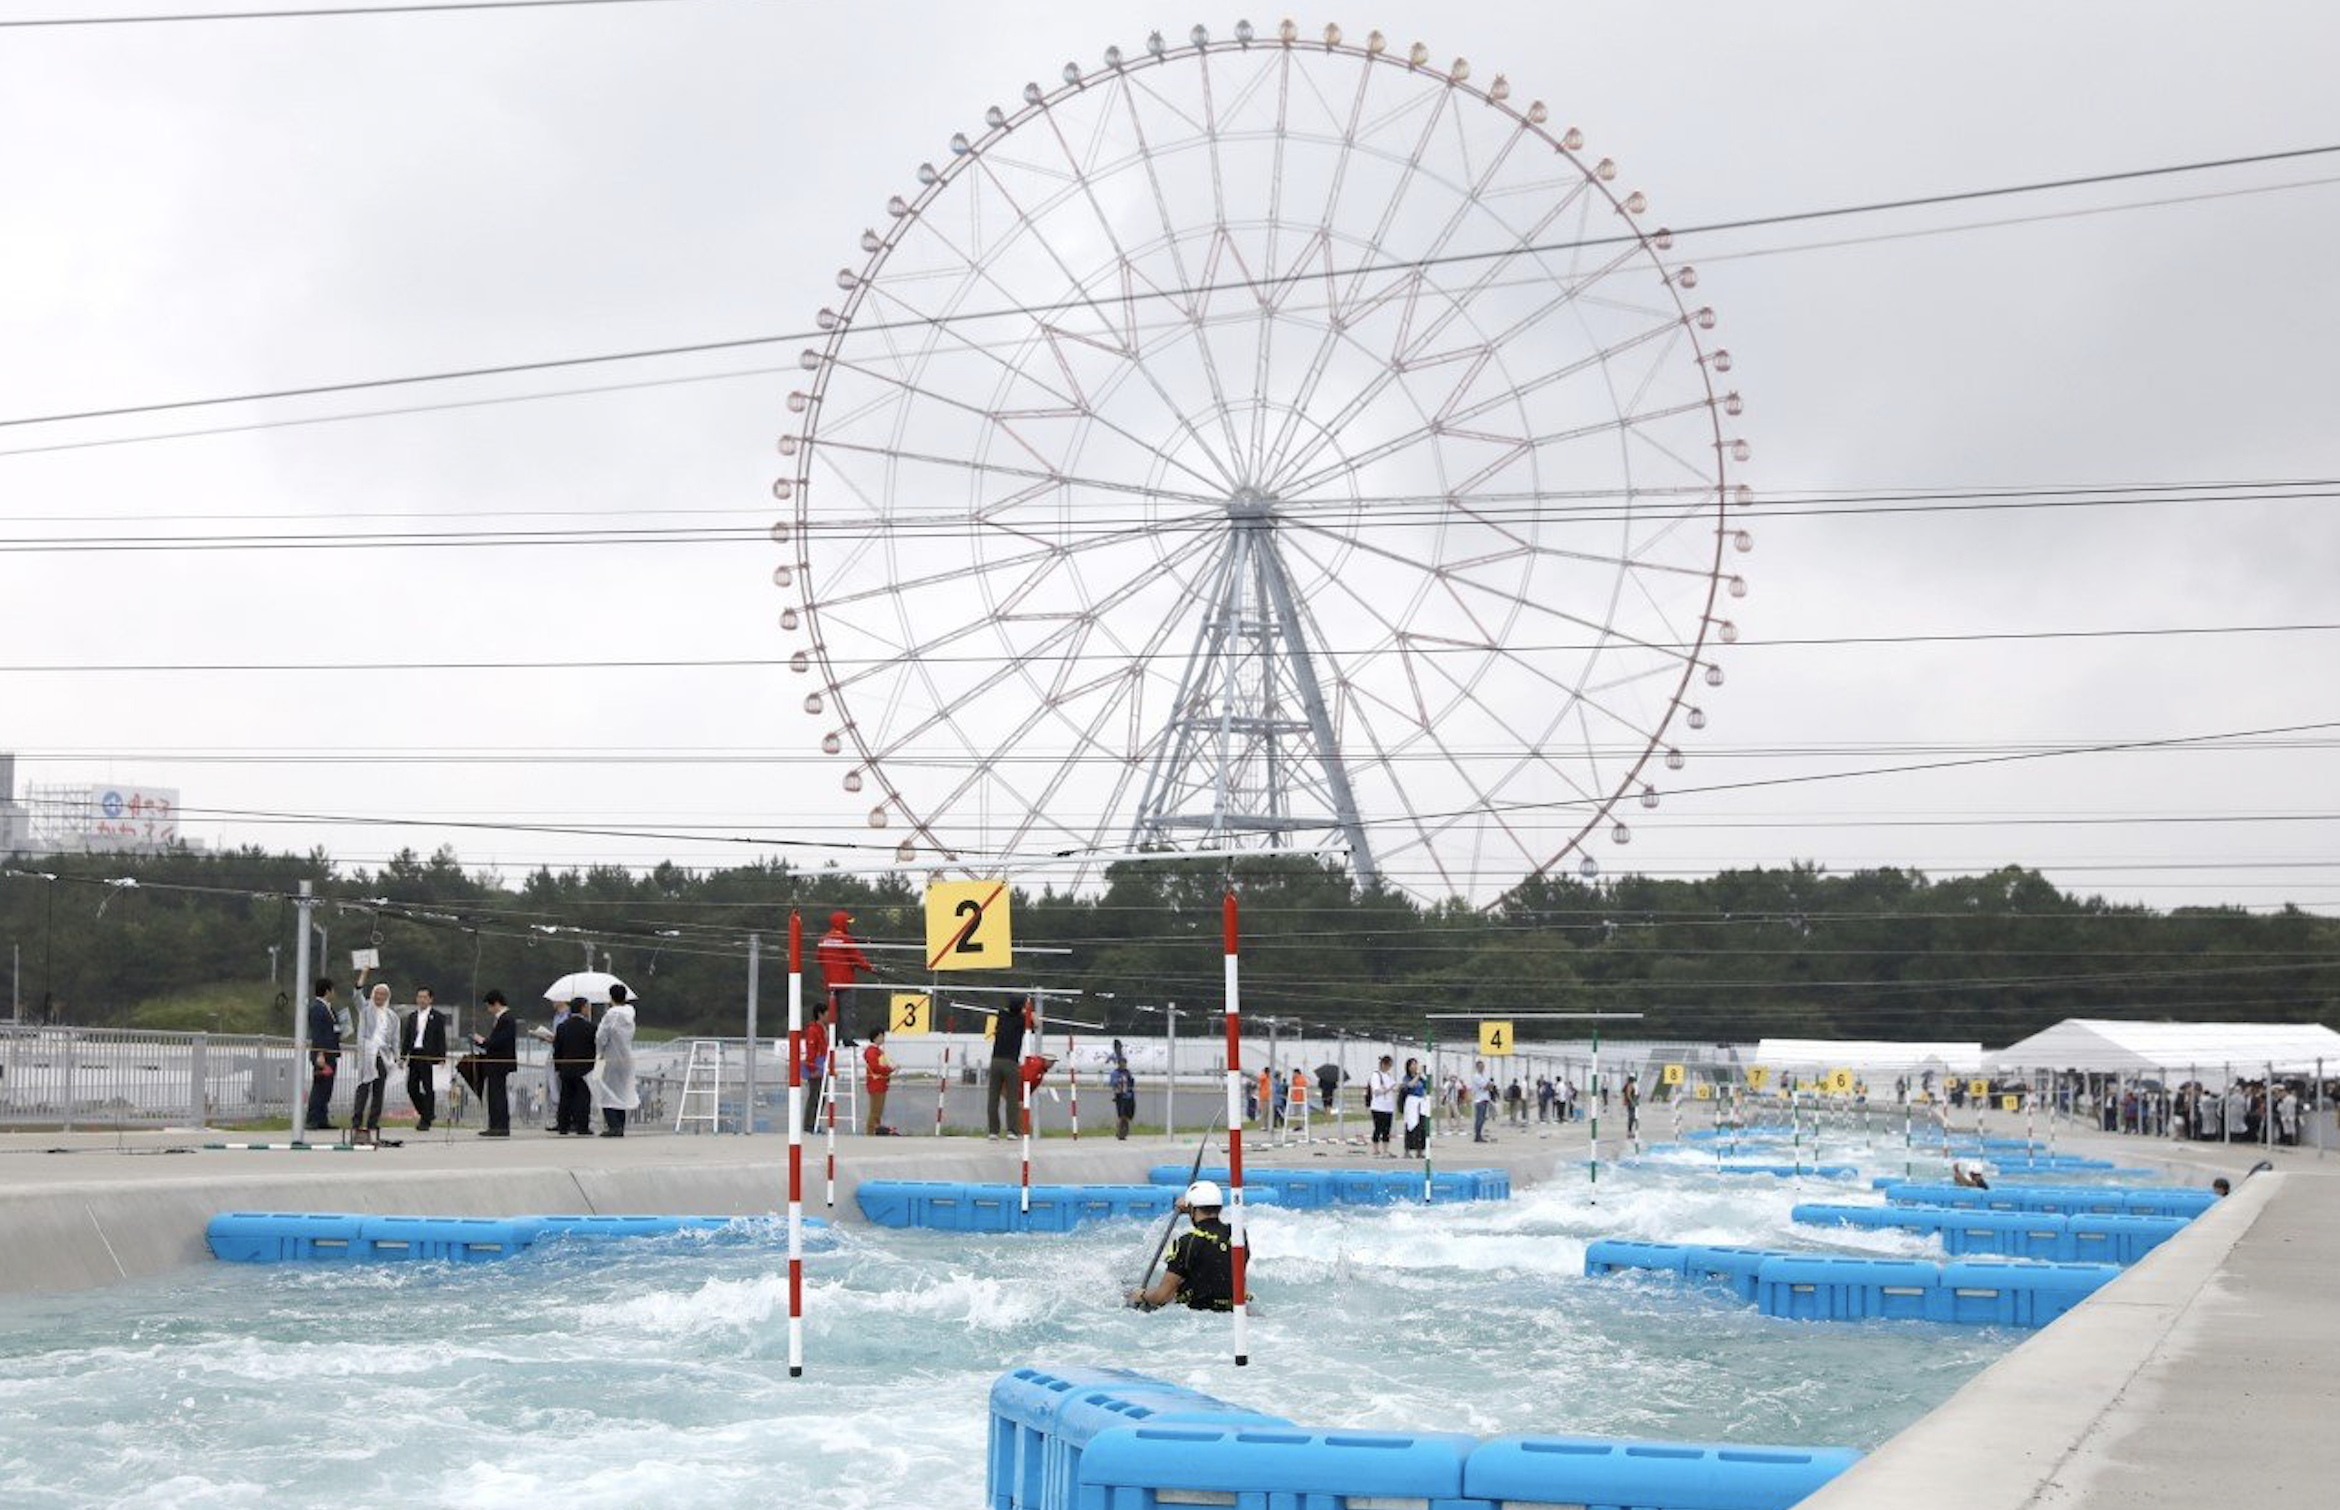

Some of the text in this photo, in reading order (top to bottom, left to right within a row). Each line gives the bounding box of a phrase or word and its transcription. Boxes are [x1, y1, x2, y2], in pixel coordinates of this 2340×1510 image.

[955, 900, 984, 953] 2
[904, 1003, 916, 1027] 3
[1490, 1029, 1502, 1049] 4
[1670, 1068, 1678, 1080] 8
[1754, 1070, 1761, 1081] 7
[1837, 1074, 1846, 1088] 6
